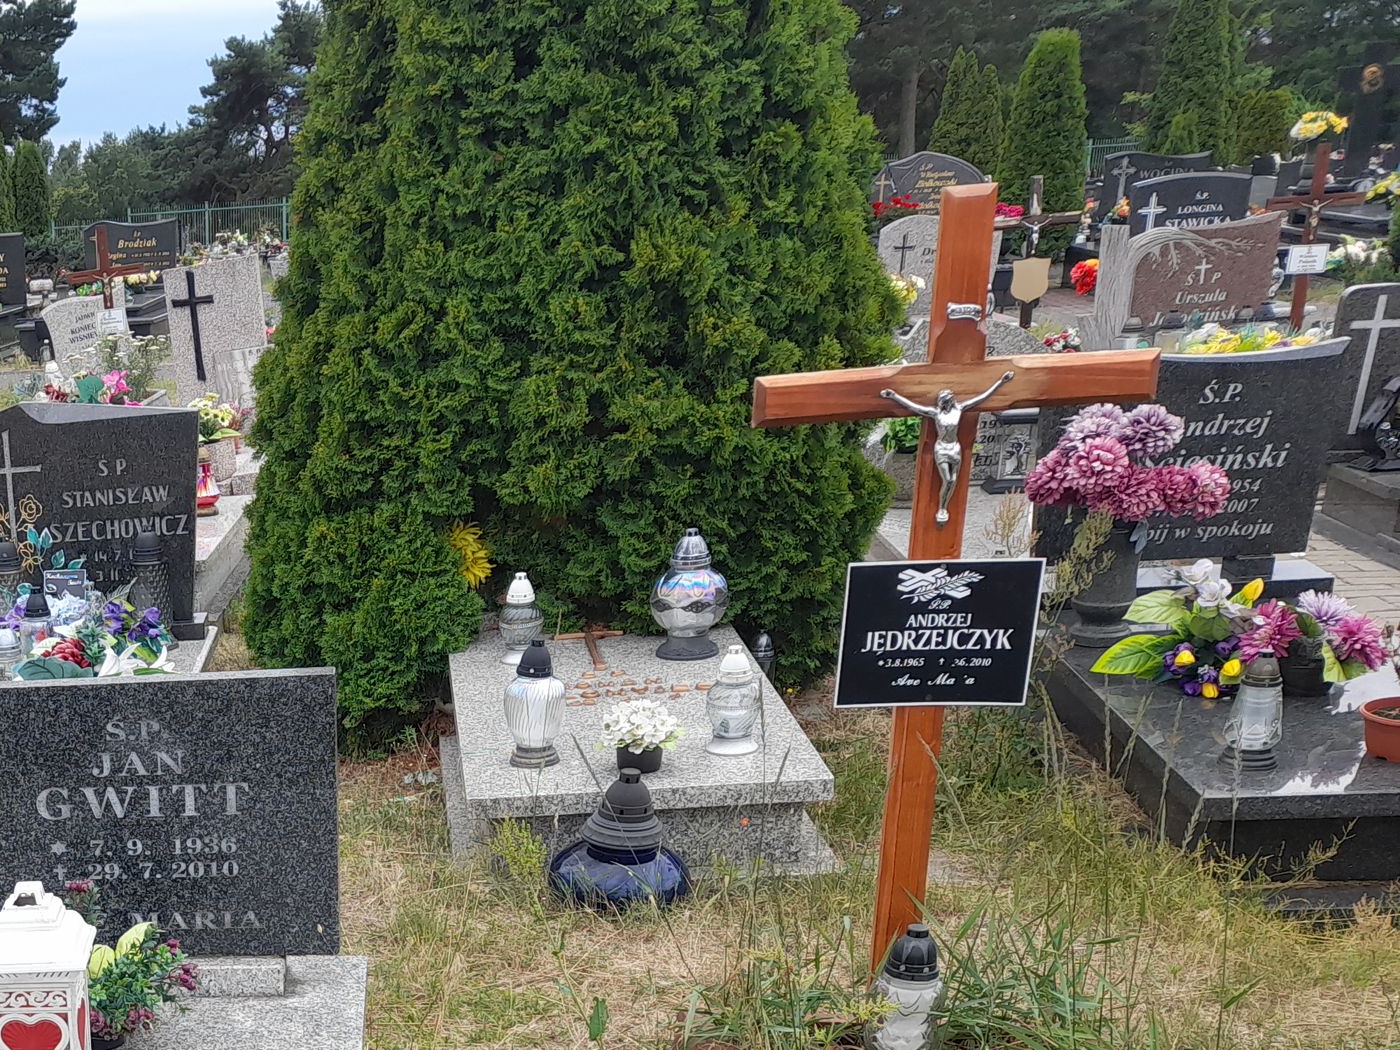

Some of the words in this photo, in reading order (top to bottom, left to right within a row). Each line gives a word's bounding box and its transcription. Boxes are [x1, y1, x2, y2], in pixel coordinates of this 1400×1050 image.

[1177, 204, 1224, 214] LONGINA
[118, 237, 157, 249] Brodziak
[1175, 288, 1227, 305] Urszula
[1186, 409, 1273, 439] ndrzej
[62, 485, 170, 509] STANISŁAW
[49, 514, 190, 543] SZECHOWICZ
[1148, 524, 1169, 544] pij
[1195, 519, 1273, 542] spokoju
[906, 613, 972, 627] ANDRZEJ
[861, 628, 1014, 655] JĘDRZEJCZYK
[891, 674, 921, 686] Ave
[92, 750, 186, 777] JAN
[36, 781, 249, 820] GWITT
[172, 837, 237, 855] 1936
[172, 860, 239, 878] 2010
[128, 910, 266, 930] MARIA
